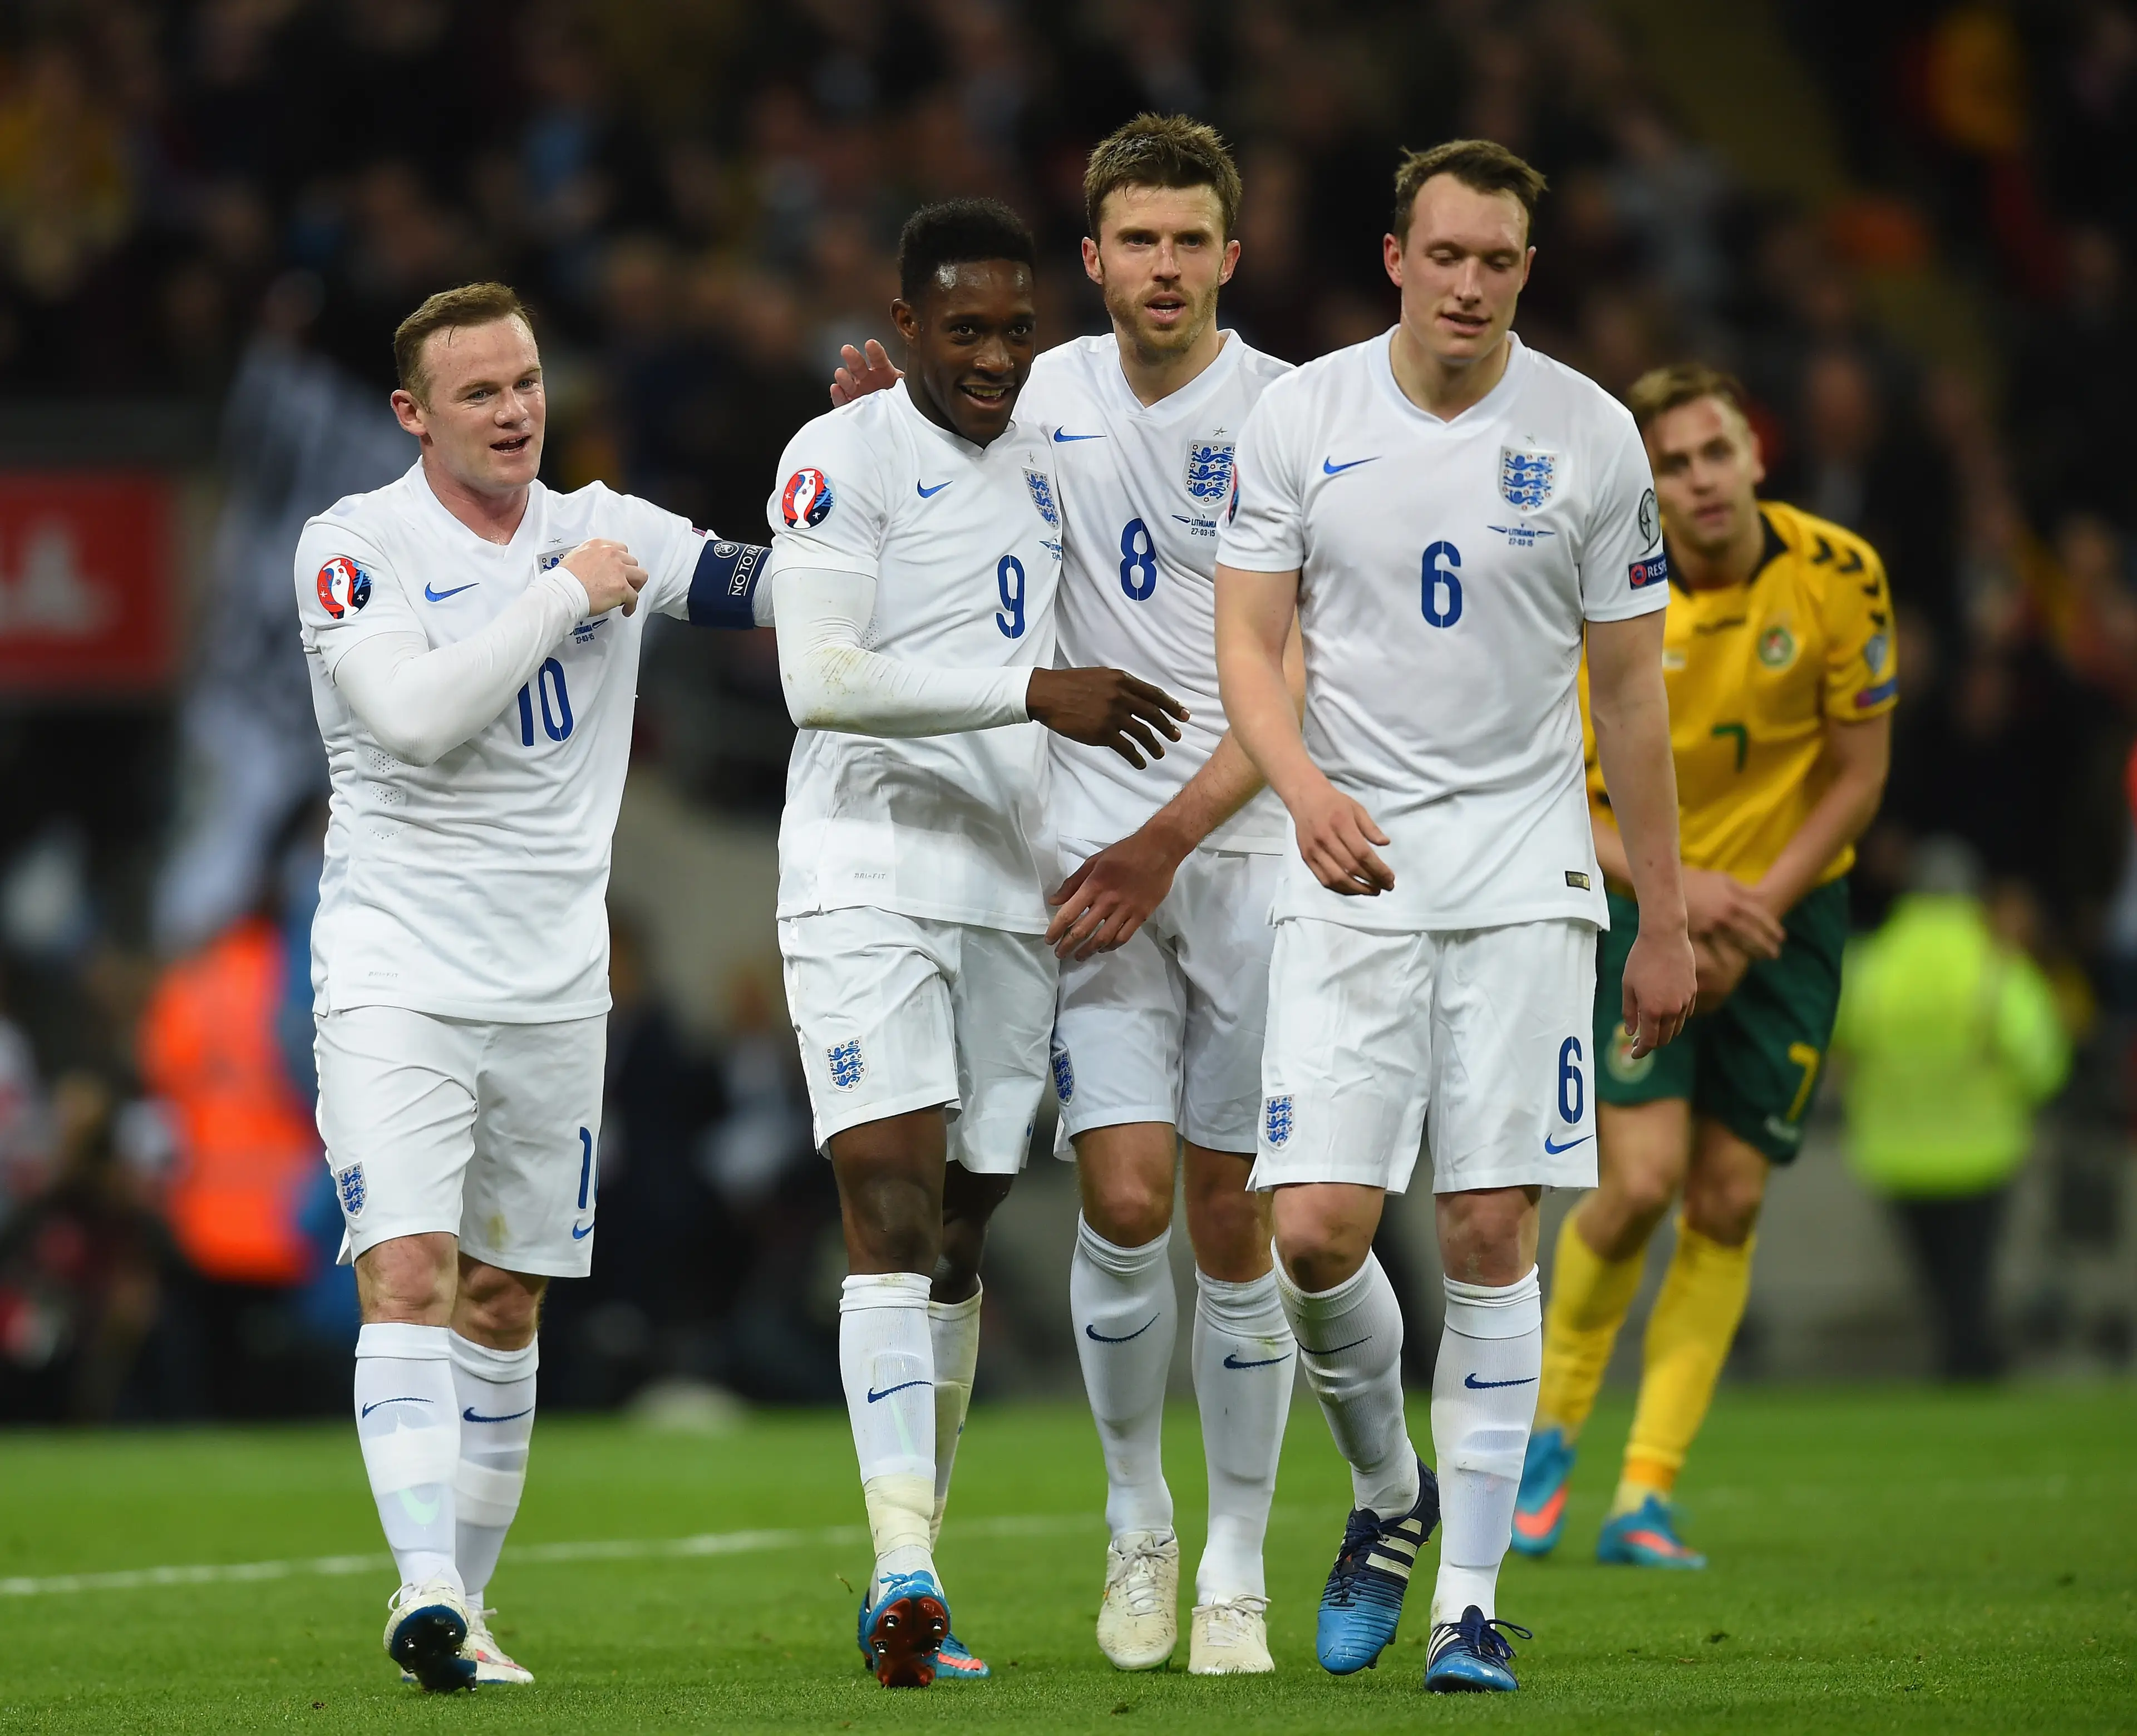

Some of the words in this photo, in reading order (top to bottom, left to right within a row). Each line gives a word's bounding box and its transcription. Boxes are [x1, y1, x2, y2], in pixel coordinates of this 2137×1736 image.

[738, 556, 754, 572] TO
[1120, 518, 1157, 601] 8
[1191, 519, 1217, 528] LITHUANIA
[731, 574, 746, 596] NO
[996, 554, 1025, 638] 9
[1421, 540, 1462, 628] 6
[518, 657, 574, 746] 10
[1712, 725, 1747, 773] 7
[1558, 1036, 1584, 1124] 6
[1788, 1041, 1819, 1122] 7
[578, 1126, 599, 1209] 1
